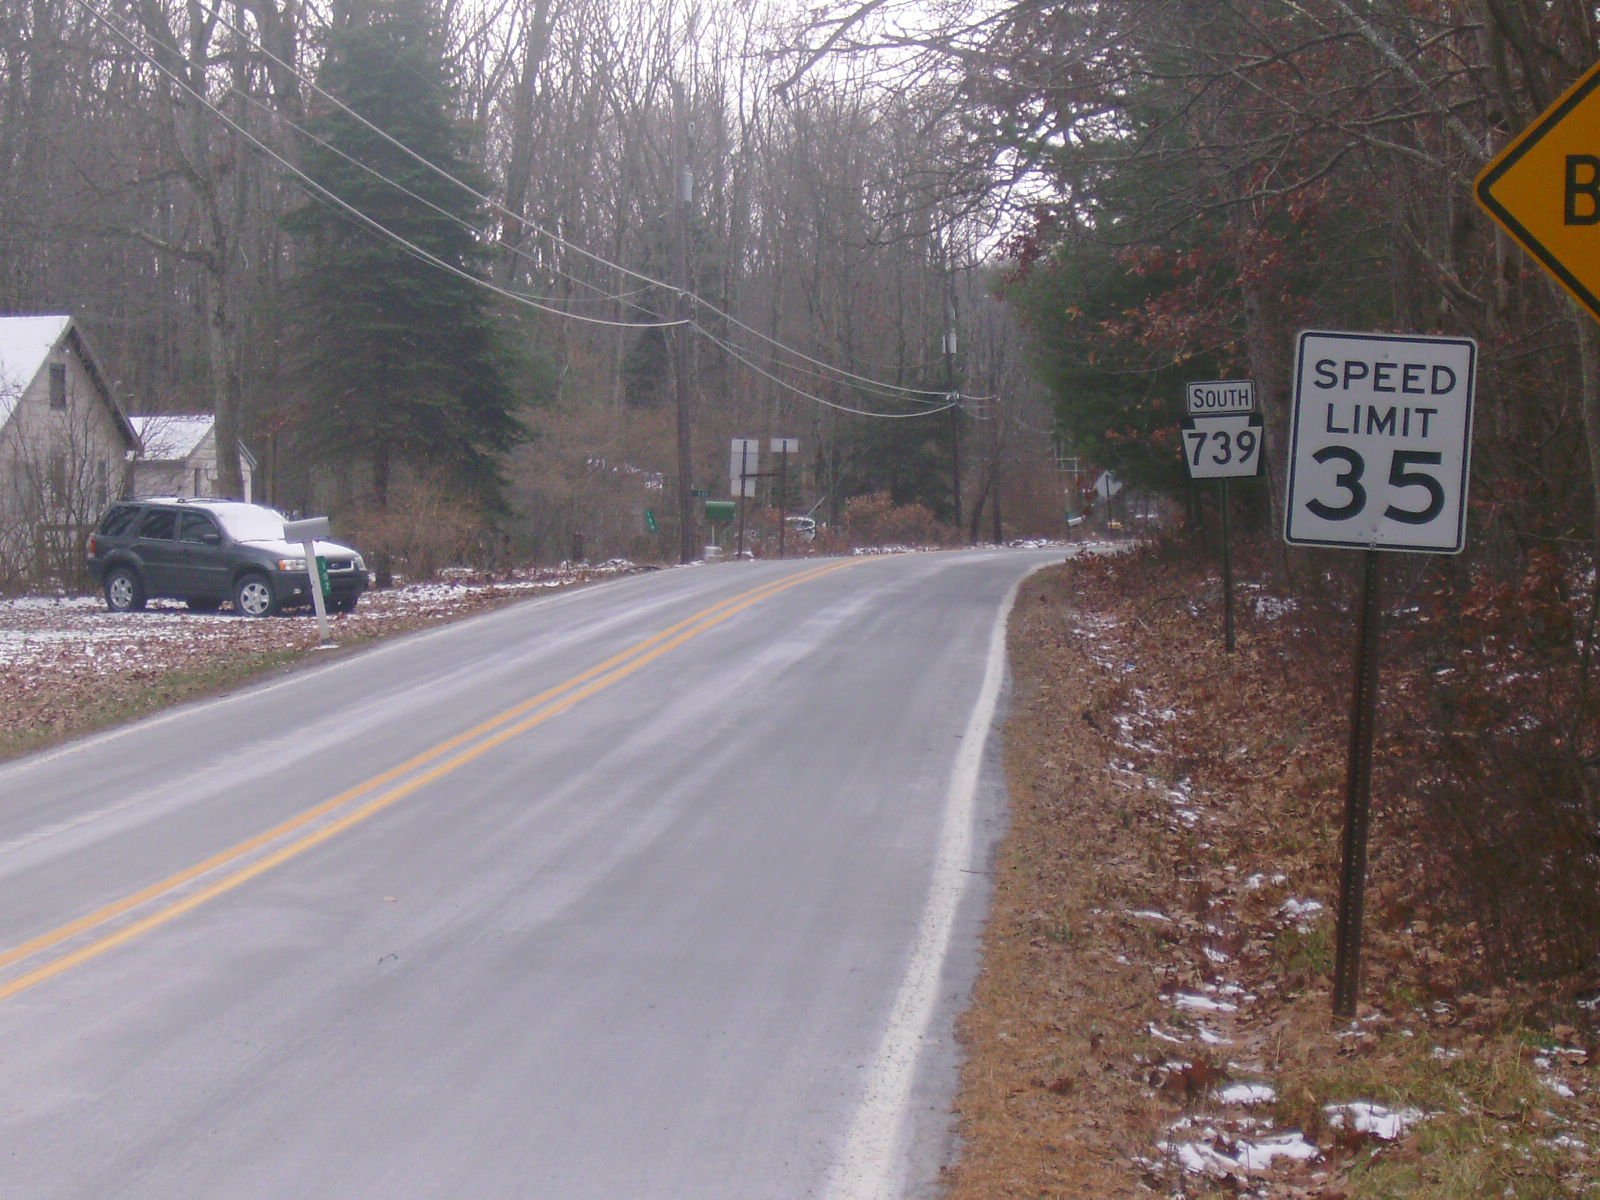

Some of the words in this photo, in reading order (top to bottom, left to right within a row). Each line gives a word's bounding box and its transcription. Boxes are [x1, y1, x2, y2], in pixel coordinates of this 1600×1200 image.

[1314, 358, 1456, 395] SPEED
[1193, 388, 1249, 408] SOUTH
[1326, 403, 1438, 438] LIMIT
[1188, 430, 1256, 466] 739
[1305, 445, 1445, 525] 35
